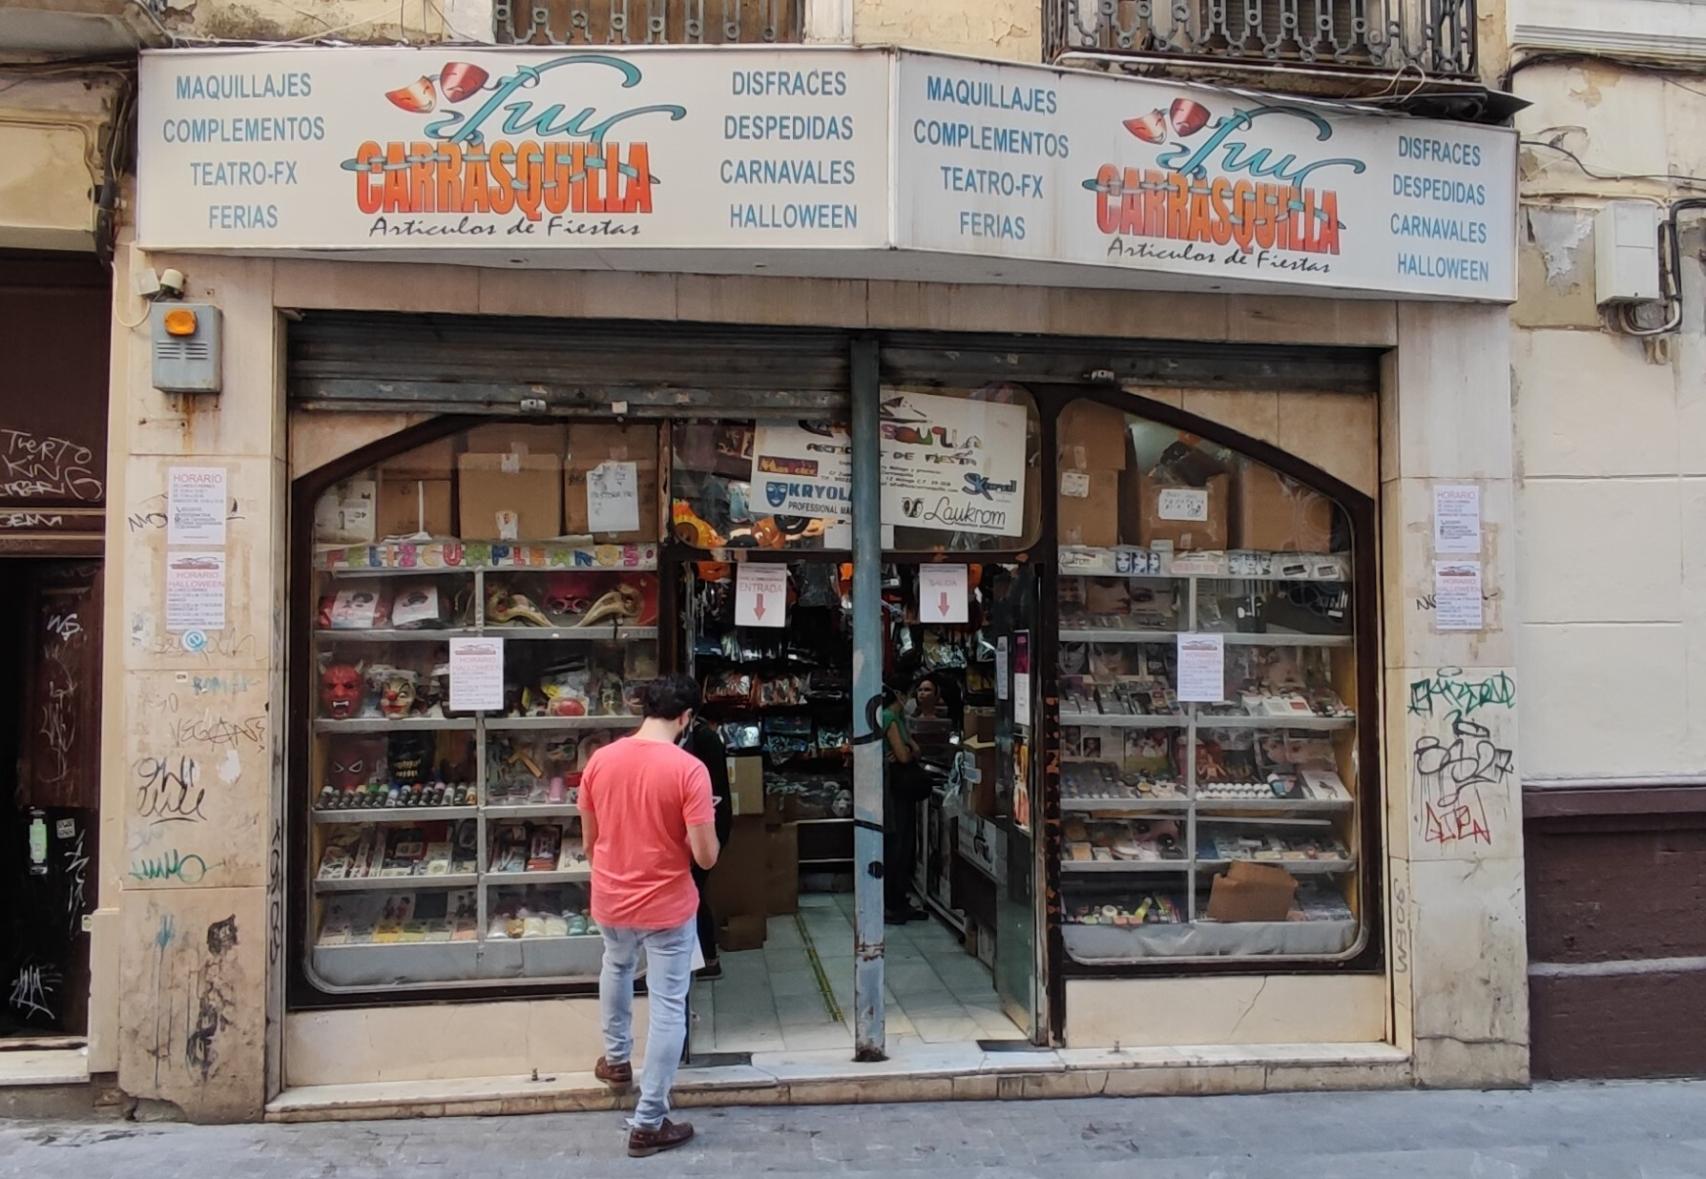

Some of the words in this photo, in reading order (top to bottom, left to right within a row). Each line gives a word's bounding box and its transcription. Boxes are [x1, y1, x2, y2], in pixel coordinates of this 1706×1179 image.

[176, 73, 312, 99] MAQUILLAJES
[732, 71, 847, 96] DISFRACES
[927, 75, 1057, 114] MAQUILLAJES
[163, 116, 325, 142] COMPLEMENTOS
[725, 115, 853, 140] DESPEDIDAS
[913, 119, 1069, 158] COMPLEMENTOS
[1398, 135, 1481, 167] DISFRACES
[190, 161, 298, 186] TEATRO-FX
[356, 139, 653, 221] CARRASQUILLA
[720, 160, 856, 185] CARNAVALES
[941, 166, 1043, 198] TEATRO-FX
[1393, 173, 1486, 206] DESPEDIDAS
[209, 204, 278, 229] FERIAS
[730, 204, 857, 229] HALLOWEEN
[1096, 163, 1340, 256] CARRASQUILLA
[507, 216, 534, 235] de
[548, 215, 640, 237] Fiestas
[960, 211, 1025, 240] FERIAS
[1390, 213, 1487, 244] CARNAVALES
[1225, 248, 1247, 265] de
[1257, 250, 1331, 273] Fiestas
[1398, 253, 1489, 282] HALLOWEEN
[173, 473, 223, 484] HORARIO
[788, 482, 852, 501] KRYOL
[788, 500, 838, 514] PROFESSIONAL
